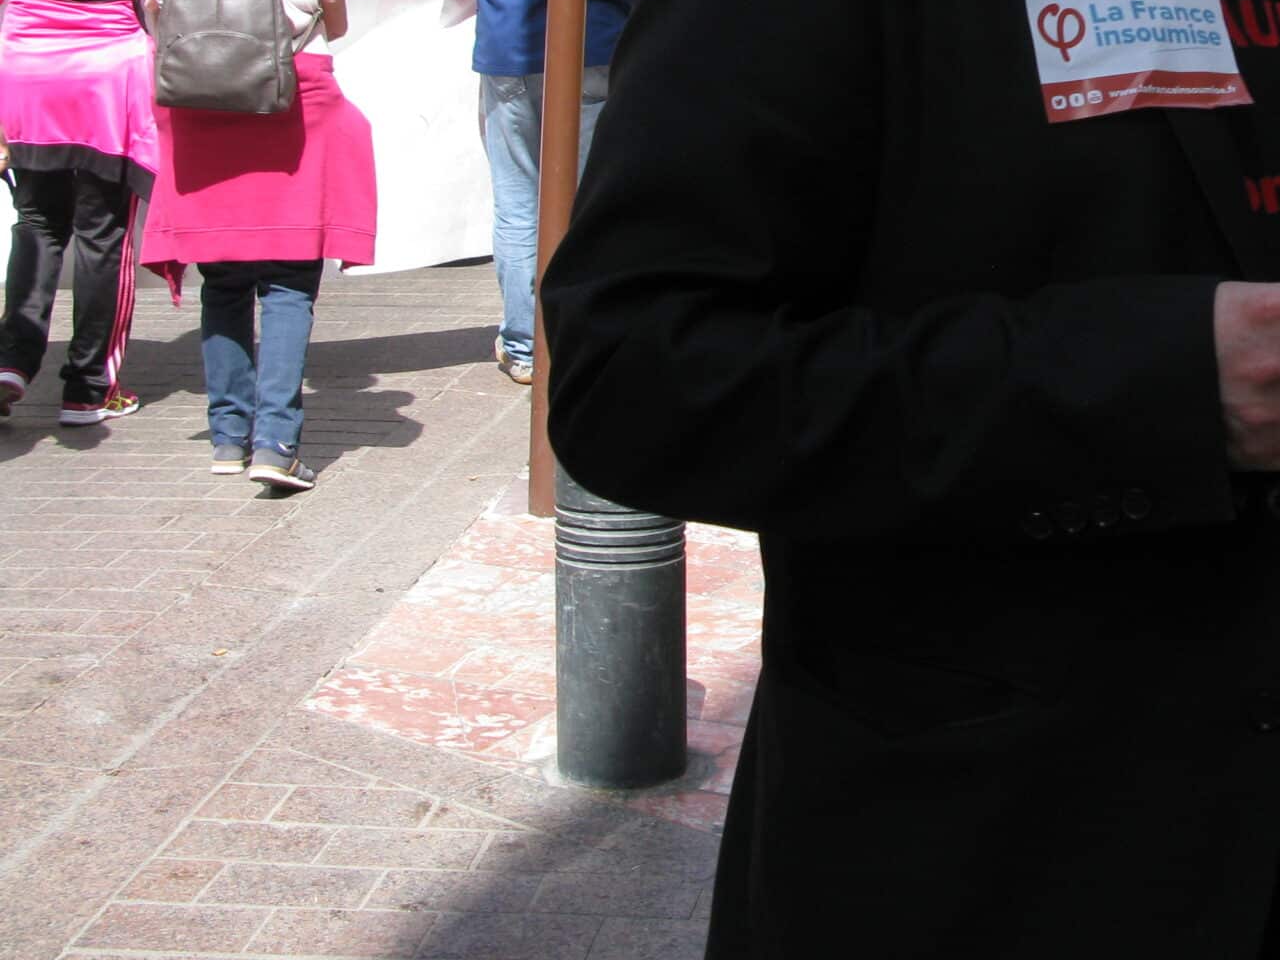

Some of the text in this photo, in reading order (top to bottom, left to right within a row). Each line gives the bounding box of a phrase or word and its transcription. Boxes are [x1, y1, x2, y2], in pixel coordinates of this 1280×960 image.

[1089, 0, 1216, 23] La France
[1094, 25, 1222, 47] insoumise
